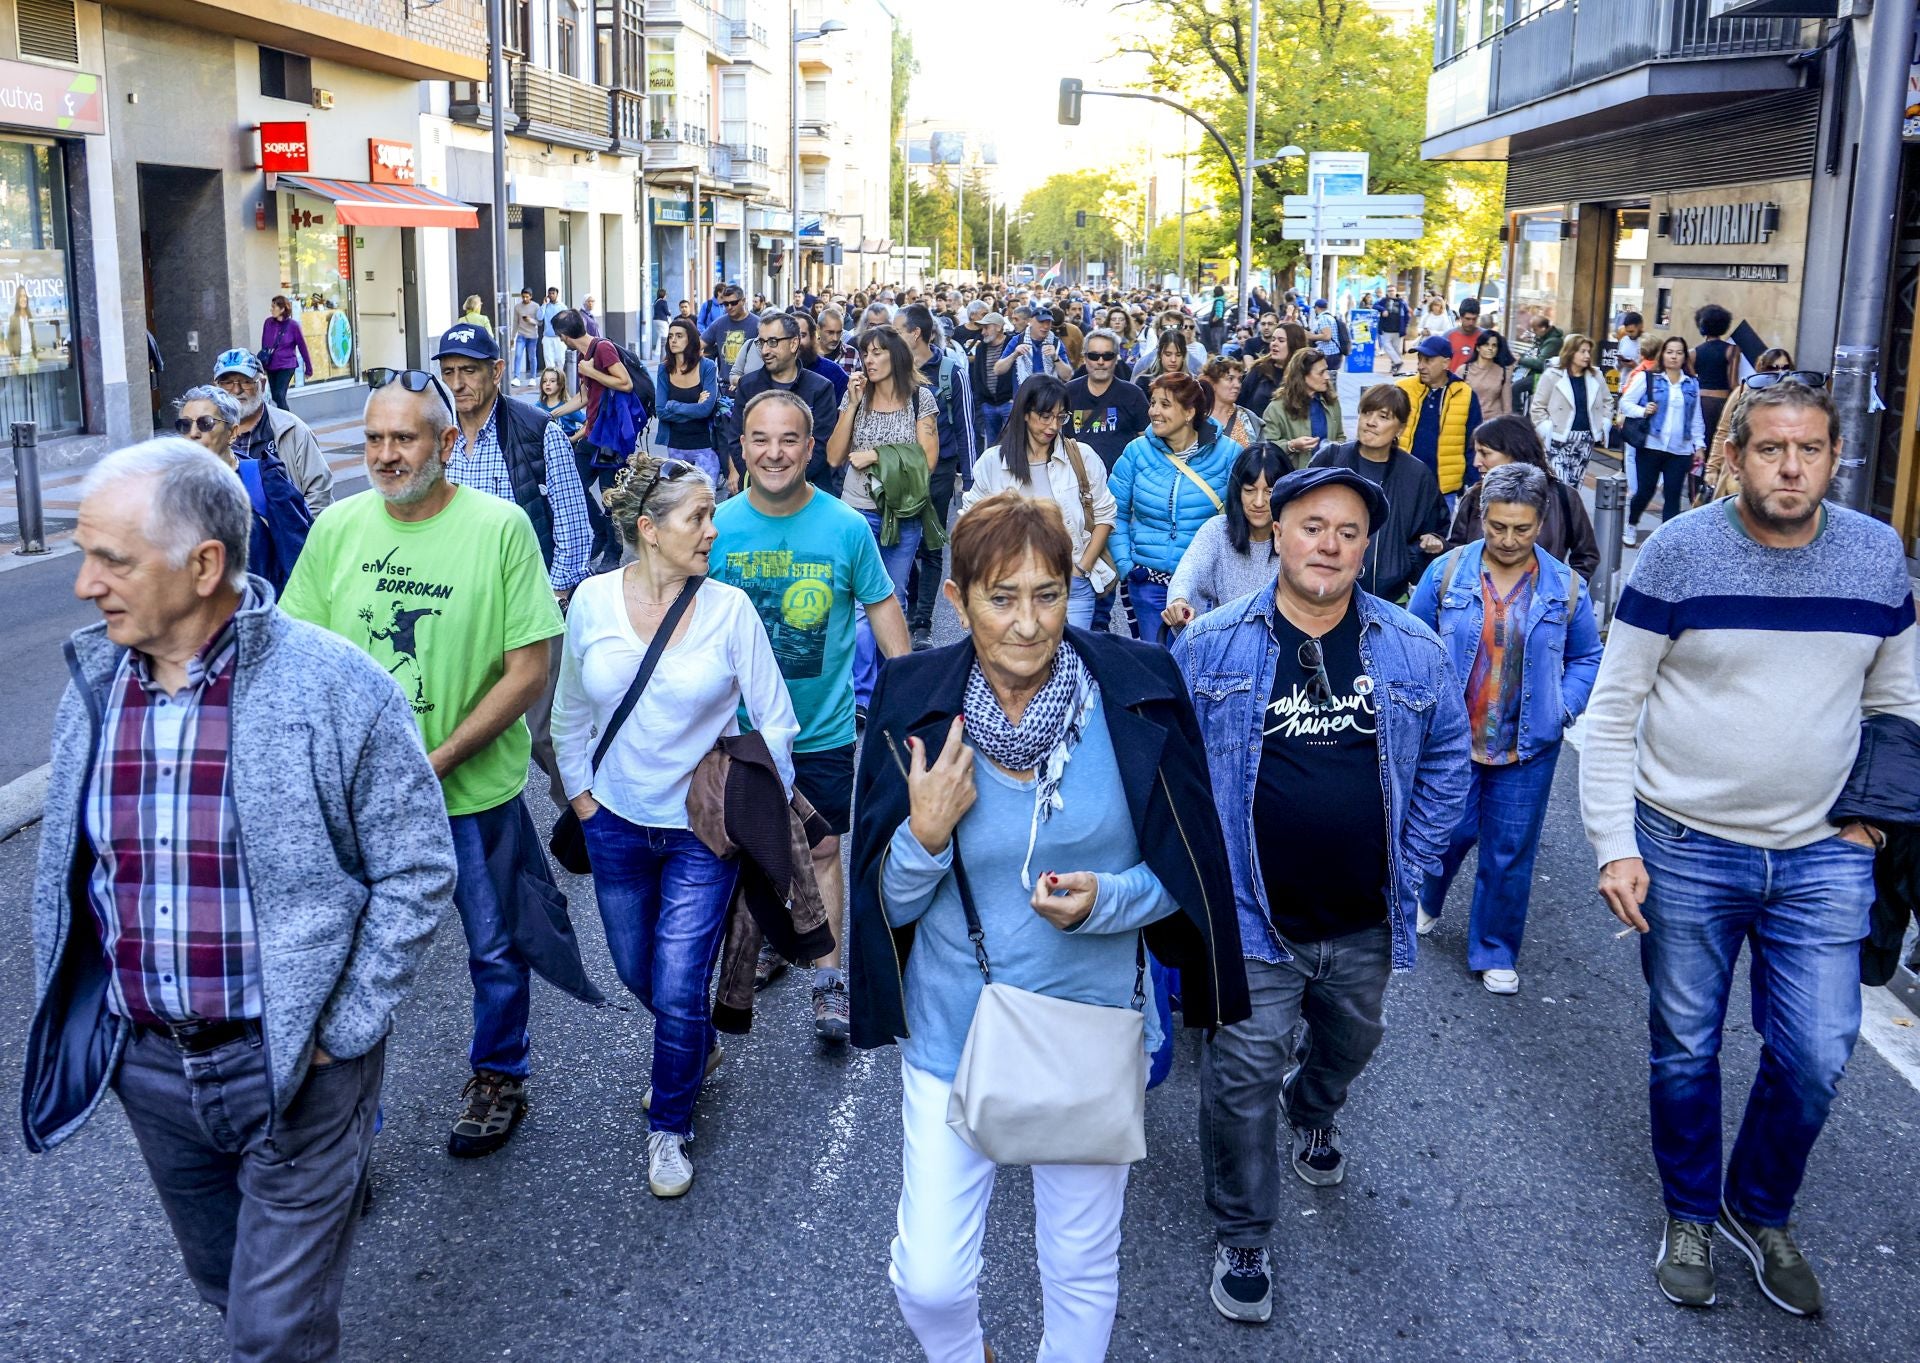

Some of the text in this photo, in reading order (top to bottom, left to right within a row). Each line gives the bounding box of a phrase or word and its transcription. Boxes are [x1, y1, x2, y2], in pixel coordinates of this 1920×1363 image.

[265, 142, 305, 154] SQRUPS
[1727, 266, 1778, 280] LA BILBAINA
[792, 562, 832, 578] STEPS
[375, 577, 454, 599] BORROKAN
